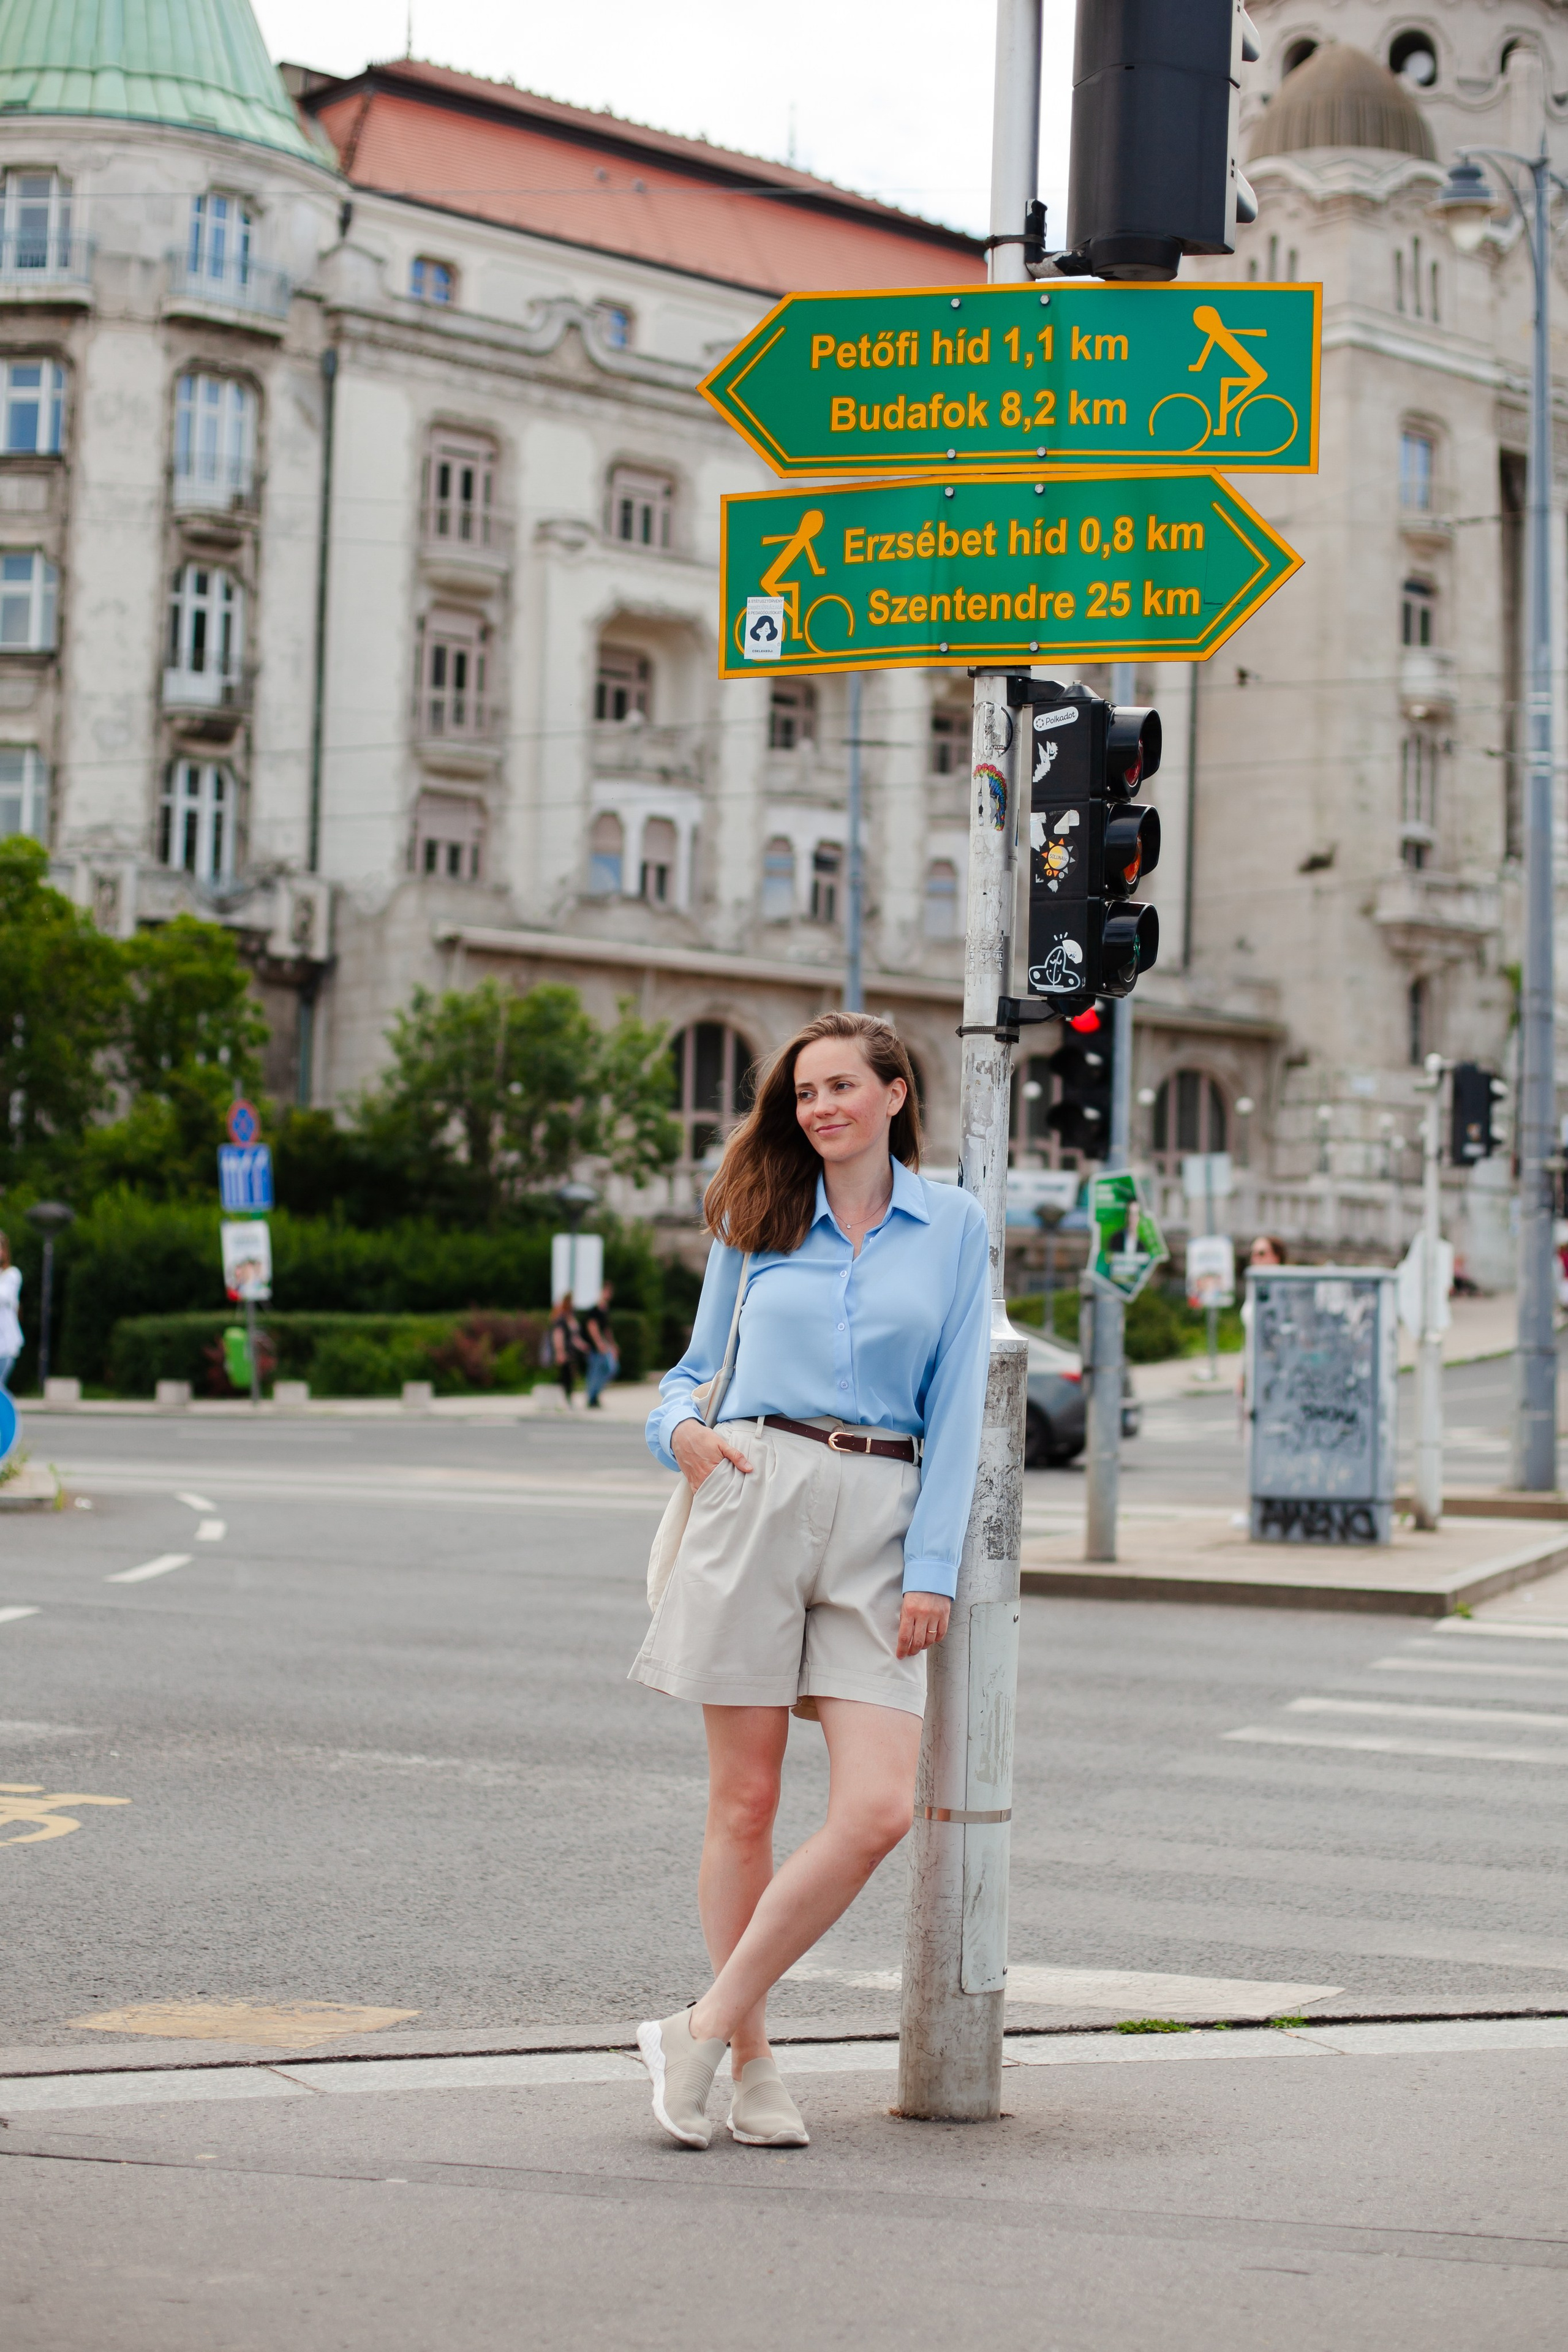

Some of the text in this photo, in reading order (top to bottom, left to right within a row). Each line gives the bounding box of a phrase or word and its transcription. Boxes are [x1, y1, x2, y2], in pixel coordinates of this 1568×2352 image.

[811, 325, 1129, 370] Petőfi híd 1,1 km
[830, 388, 1127, 433] Budafok 8,2 km
[843, 514, 1205, 564] Erzsébet híd 0,8 km
[868, 579, 1200, 625] Szentendre 25 km
[1046, 711, 1076, 725] Polkadot
